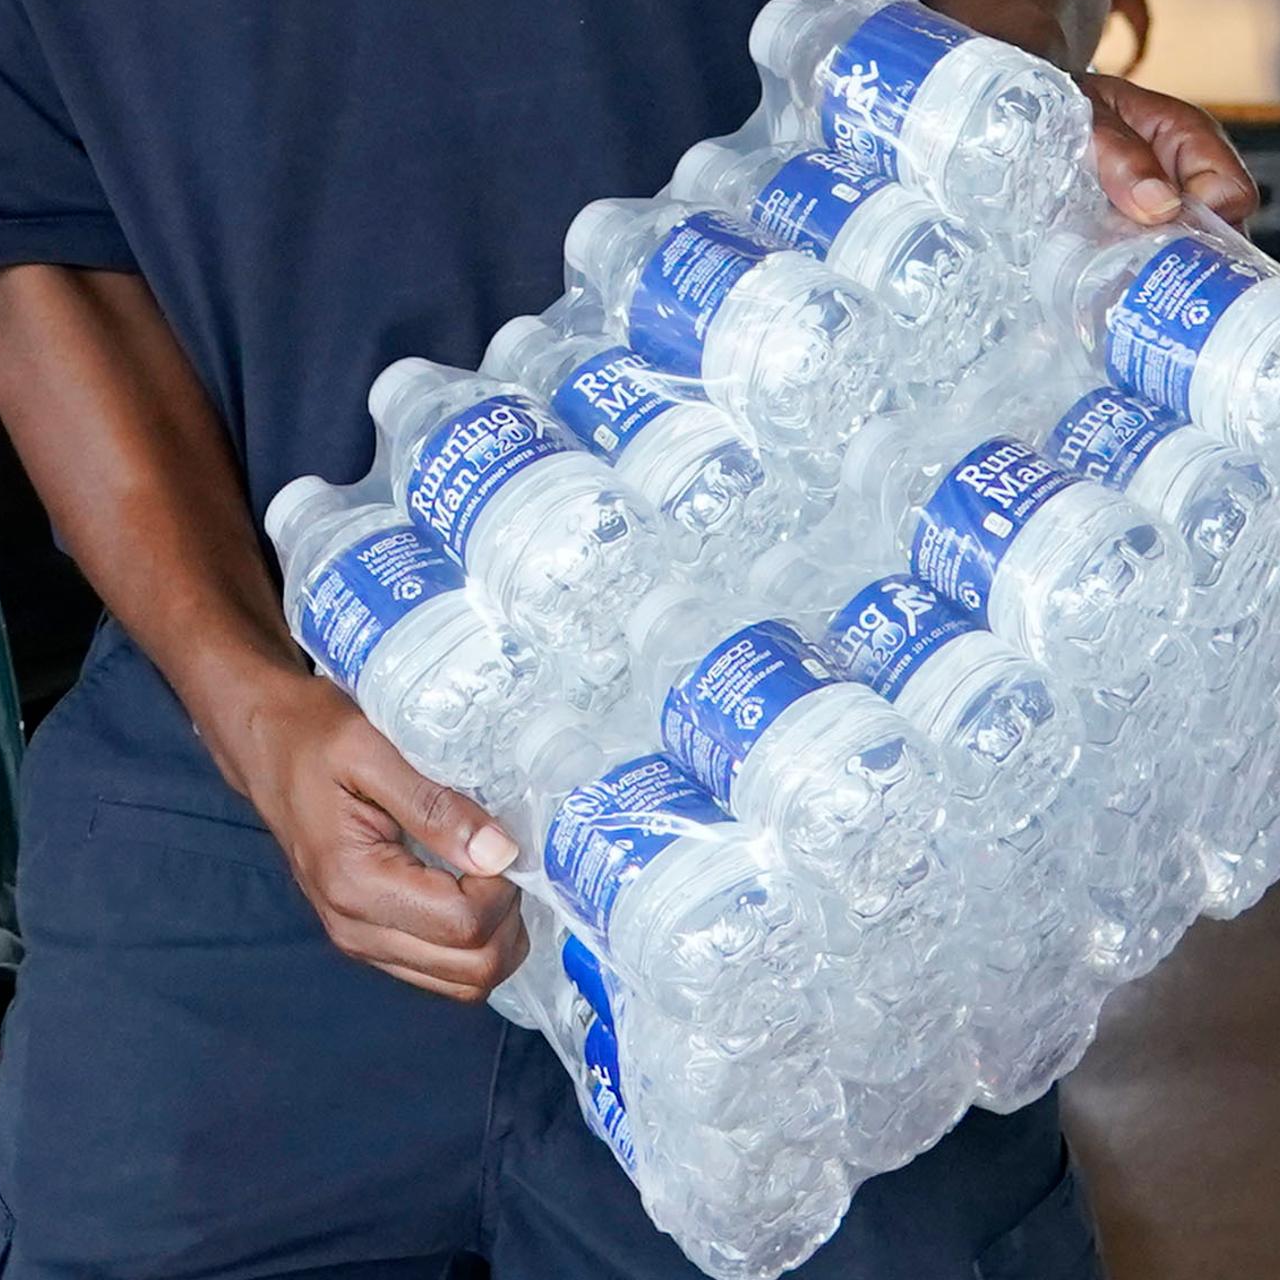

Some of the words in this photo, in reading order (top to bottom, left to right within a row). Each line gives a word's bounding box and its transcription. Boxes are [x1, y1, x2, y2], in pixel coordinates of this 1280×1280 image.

[1134, 253, 1181, 304] WESCO
[595, 378, 654, 422] Ma
[411, 405, 523, 523] Running
[503, 449, 535, 470] WATER
[430, 467, 480, 543] Man
[356, 532, 417, 563] WESCO
[696, 639, 754, 689] WESCO
[611, 760, 669, 797] WESCO
